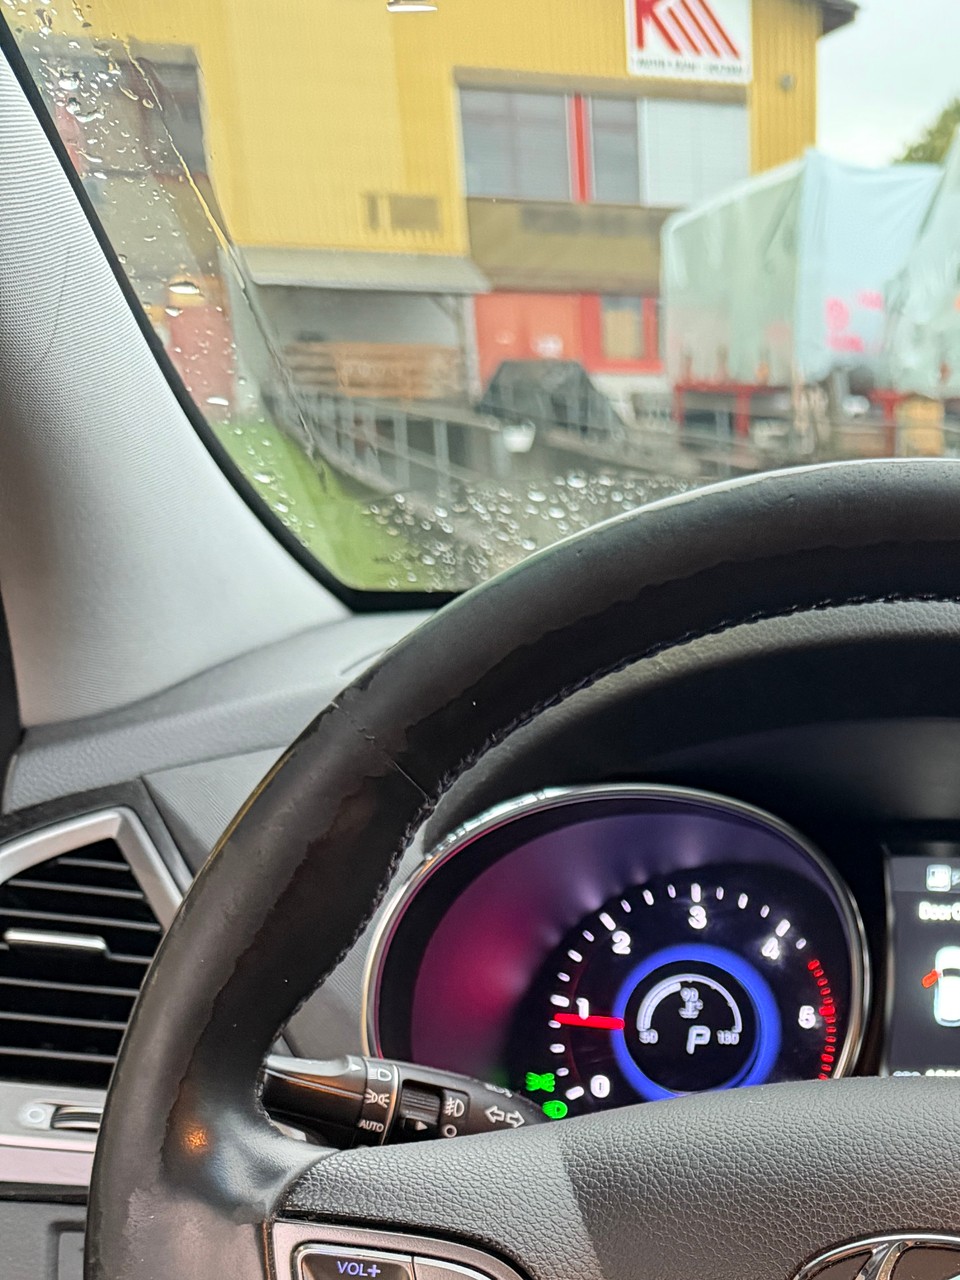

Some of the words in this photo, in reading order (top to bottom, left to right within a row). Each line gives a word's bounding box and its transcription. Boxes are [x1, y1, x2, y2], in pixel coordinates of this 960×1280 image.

[688, 905, 707, 929] 3
[612, 931, 631, 955] 2
[761, 938, 780, 960] 4
[576, 998, 589, 1020] 1
[798, 1006, 817, 1029] 5
[686, 1025, 711, 1055] P
[590, 1076, 610, 1099] 0
[357, 1119, 384, 1133] AUTO
[337, 1261, 381, 1278] VOL+
